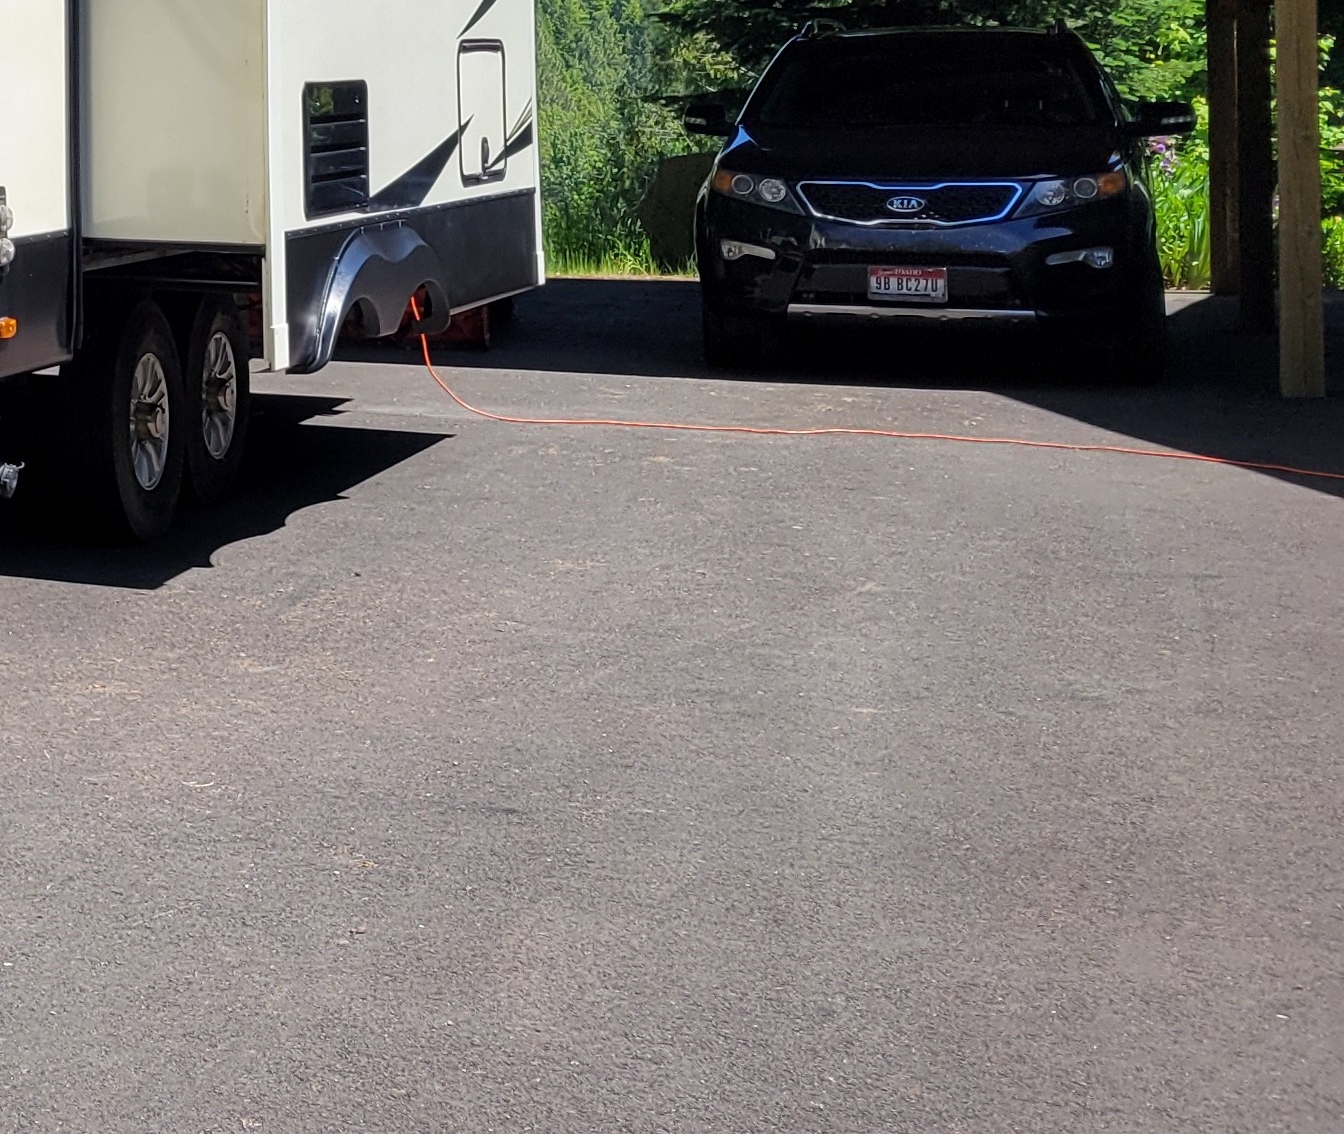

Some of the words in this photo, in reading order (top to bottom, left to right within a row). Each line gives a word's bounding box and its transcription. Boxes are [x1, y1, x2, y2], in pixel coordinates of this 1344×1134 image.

[893, 199, 918, 209] KIA
[875, 276, 891, 291] 9B
[897, 277, 938, 293] BC27U
